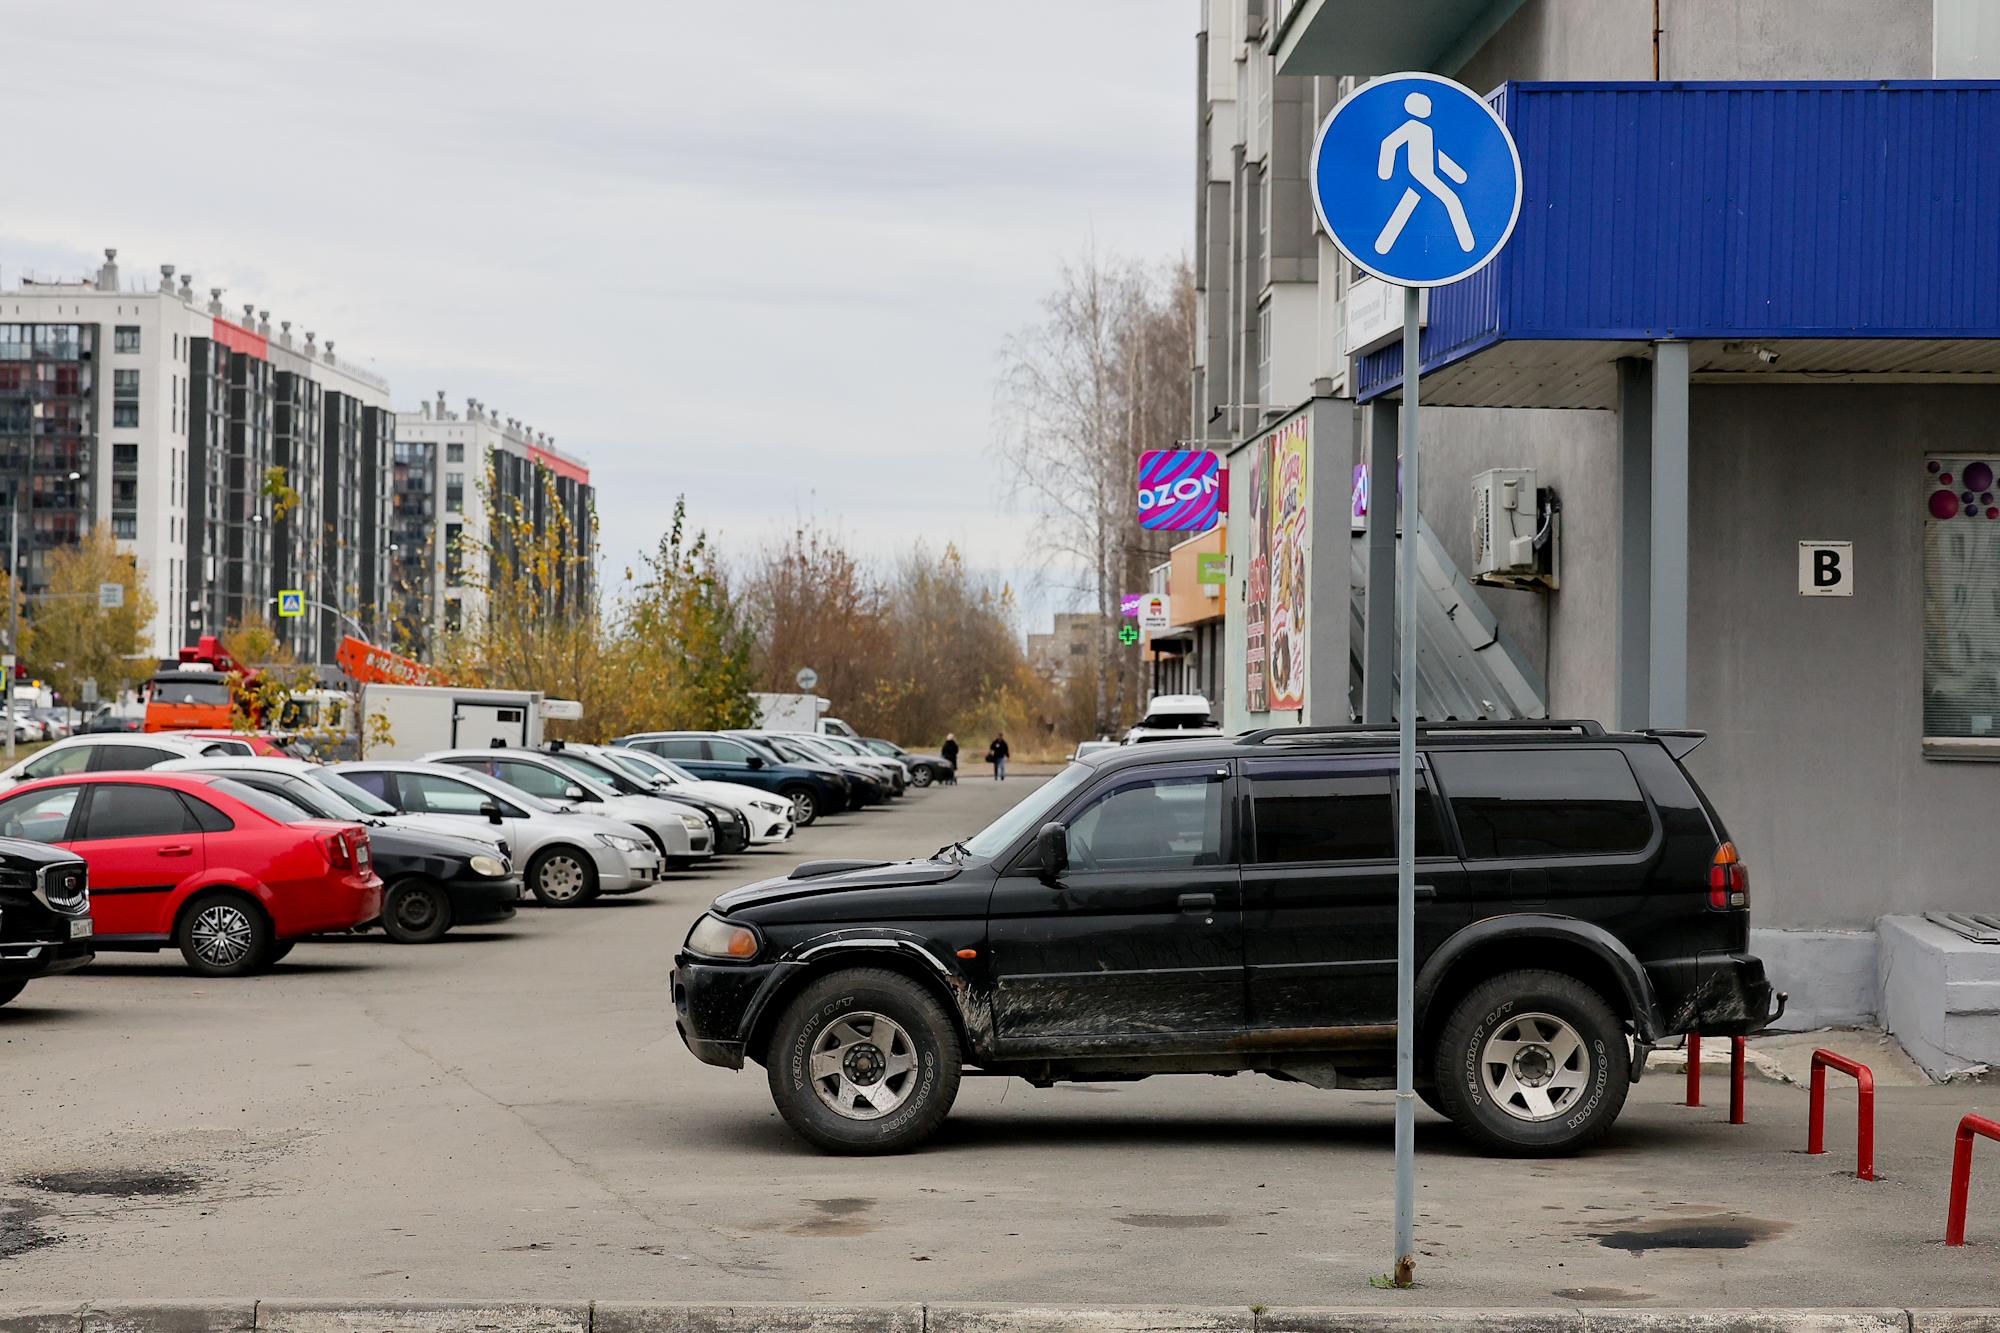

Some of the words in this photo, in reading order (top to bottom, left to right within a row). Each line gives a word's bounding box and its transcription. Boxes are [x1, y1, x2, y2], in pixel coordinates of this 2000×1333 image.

[1138, 471, 1219, 510] OZON
[792, 1013, 819, 1091] VERSANT
[824, 996, 854, 1016] A/T
[1467, 1025, 1484, 1105] VERSANT
[1486, 1001, 1513, 1025] A/T
[1568, 1040, 1607, 1129] COMPASAL
[881, 1051, 934, 1133] COMPASAL
